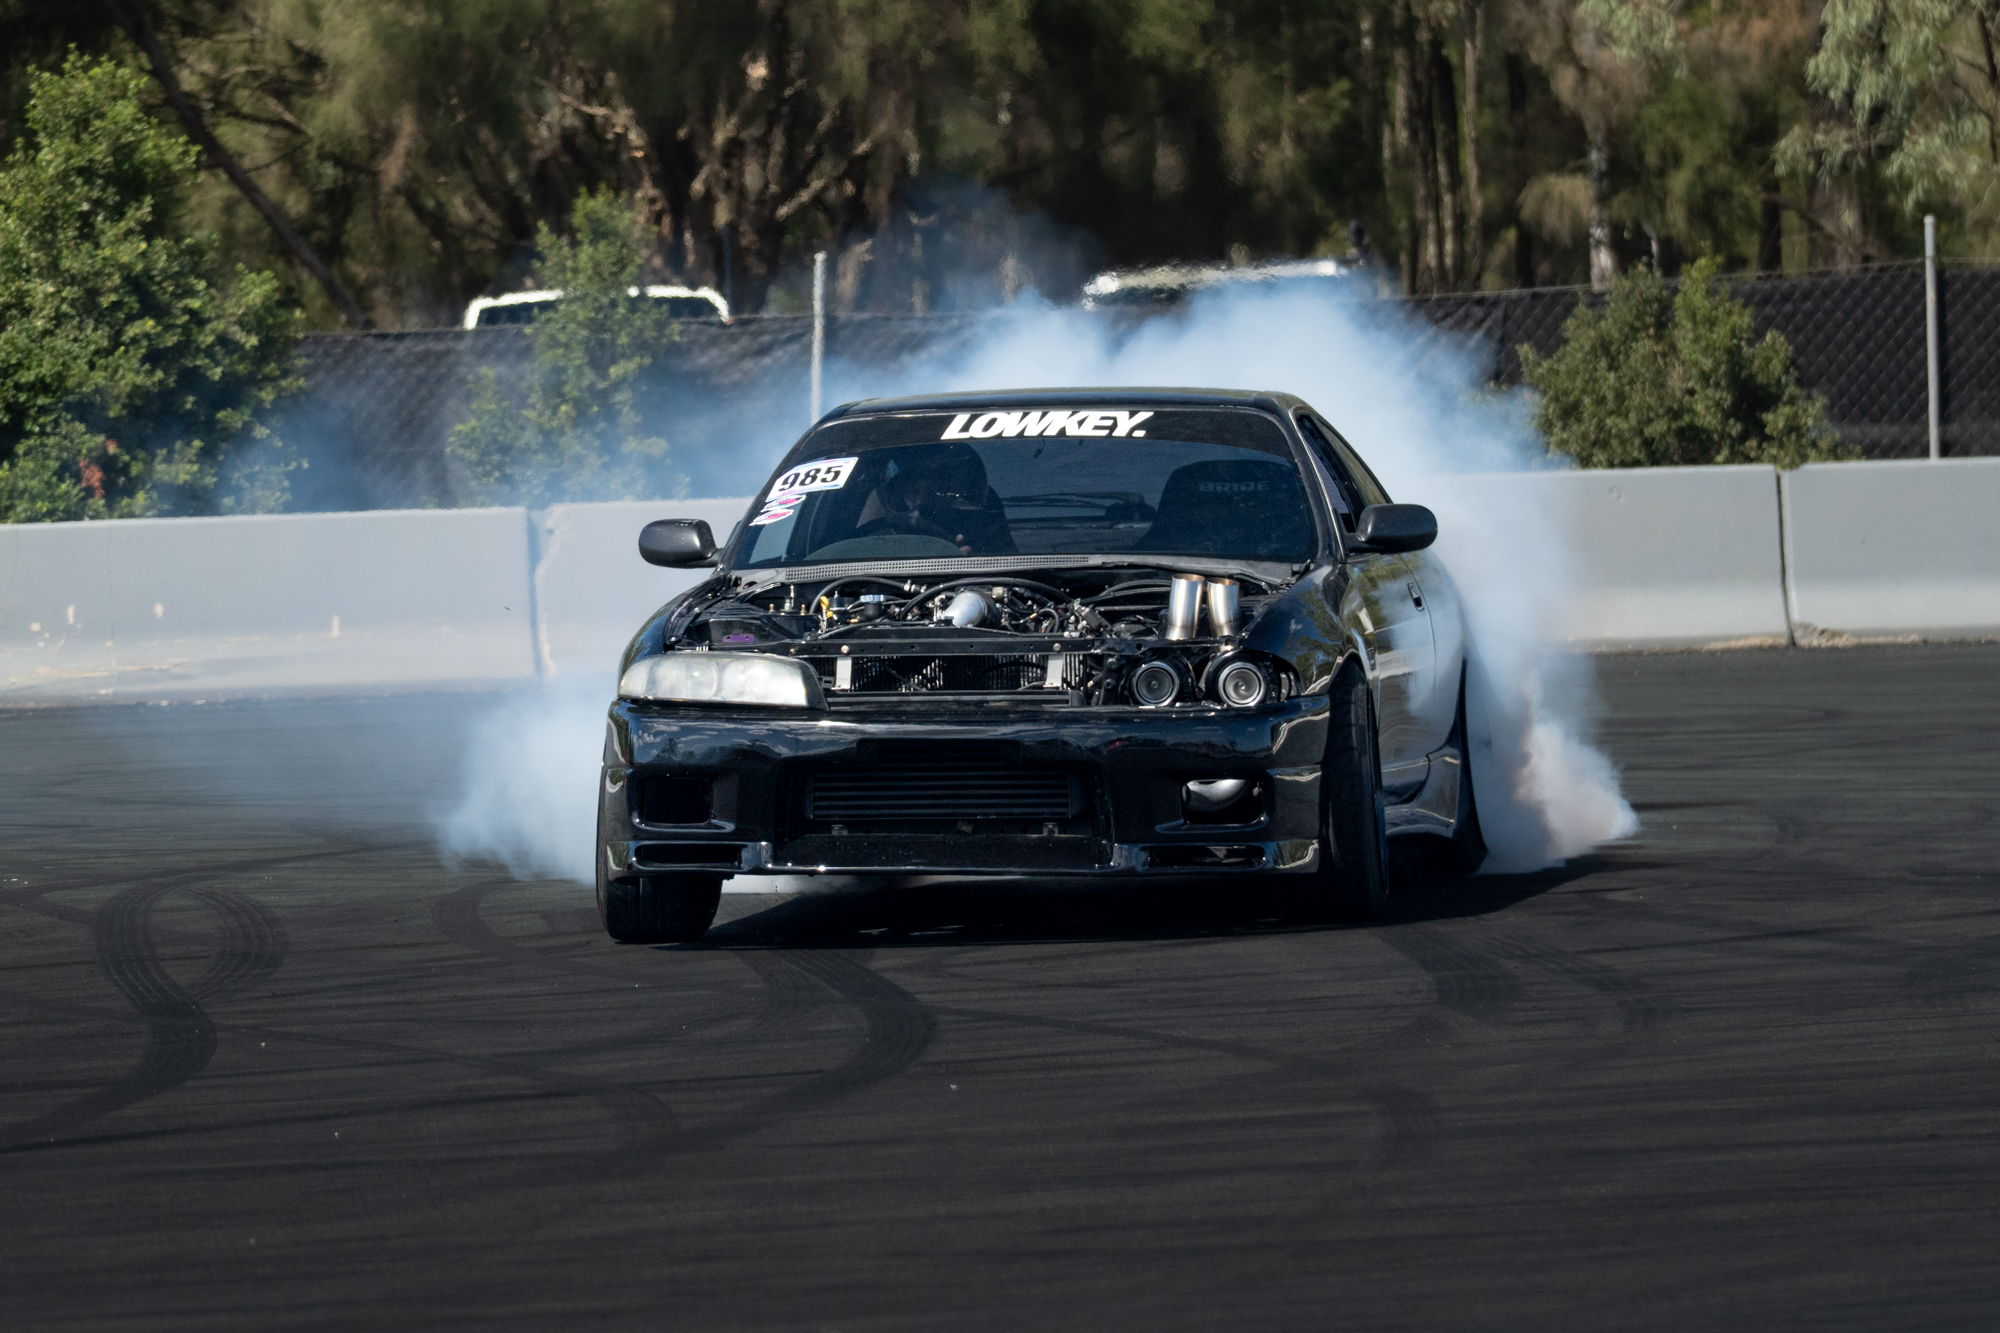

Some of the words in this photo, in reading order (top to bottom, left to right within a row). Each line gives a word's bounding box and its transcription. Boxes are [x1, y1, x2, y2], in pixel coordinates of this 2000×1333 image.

[940, 410, 1154, 440] LOWKEY.
[778, 465, 844, 492] 985
[1198, 481, 1270, 493] BRIDE
